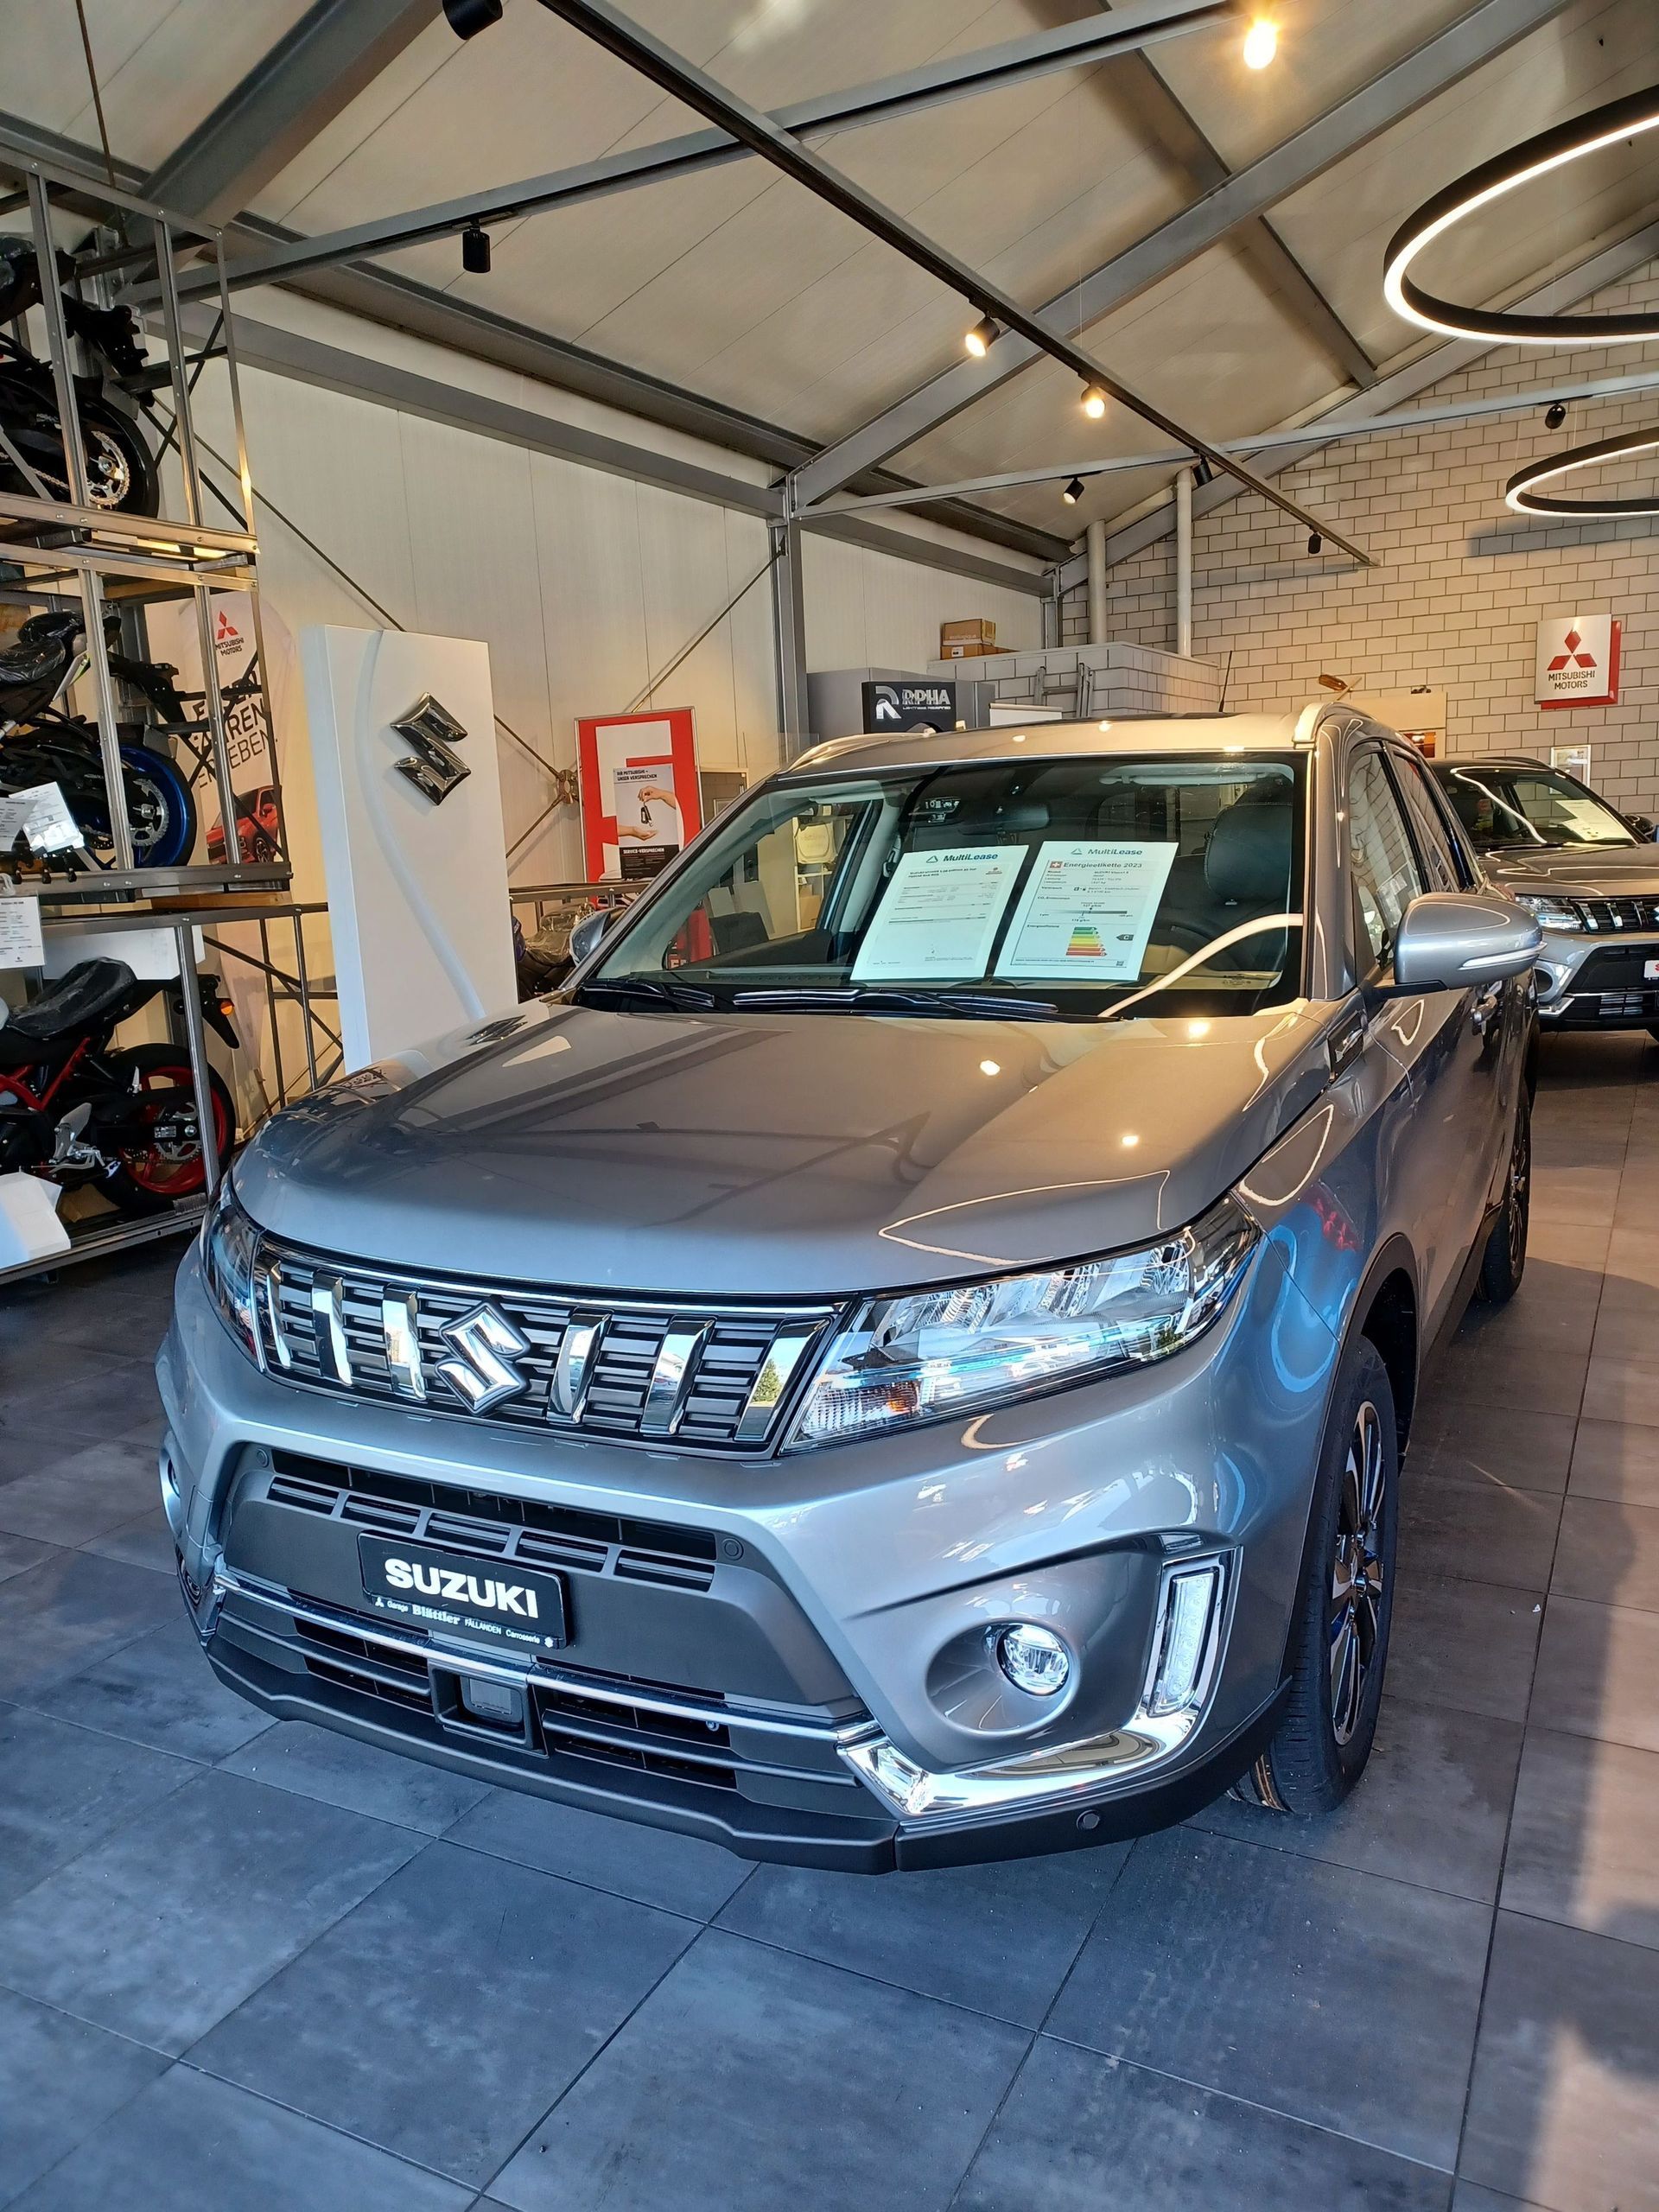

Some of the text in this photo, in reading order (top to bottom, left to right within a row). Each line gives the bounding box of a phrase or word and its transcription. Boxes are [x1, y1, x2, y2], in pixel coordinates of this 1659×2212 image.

[215, 638, 244, 650] MITSUBISHI
[220, 645, 242, 656] MOTORS
[1548, 671, 1595, 681] MITSUBISHI
[1554, 681, 1588, 690] MOTORS
[385, 1558, 539, 1618] SUZUKI
[387, 1600, 408, 1612] Garage
[505, 1629, 541, 1643] Carrosserie
